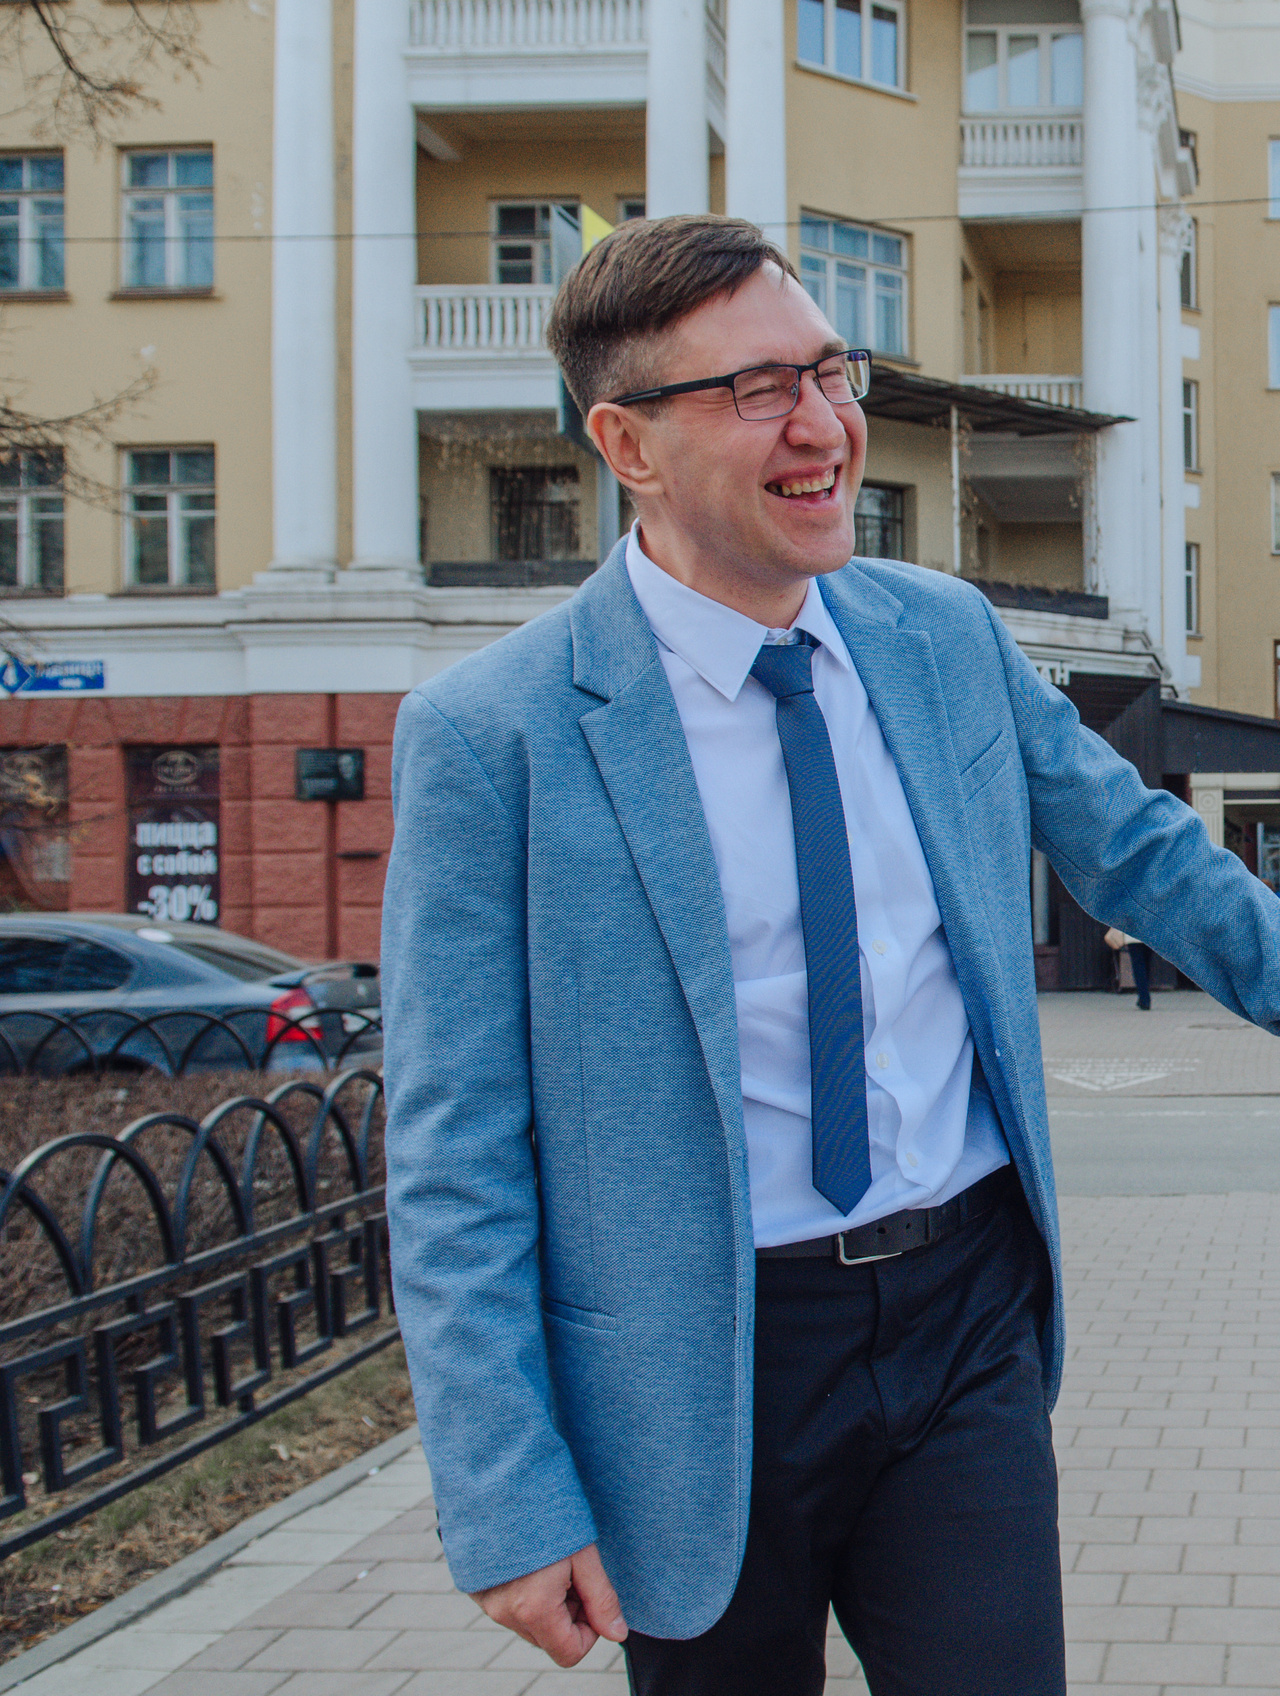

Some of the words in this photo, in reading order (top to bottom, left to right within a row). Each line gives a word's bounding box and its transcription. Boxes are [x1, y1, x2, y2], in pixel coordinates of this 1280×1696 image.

[136, 822, 217, 849] пицца
[152, 850, 217, 876] собой
[137, 884, 218, 921] -30%
